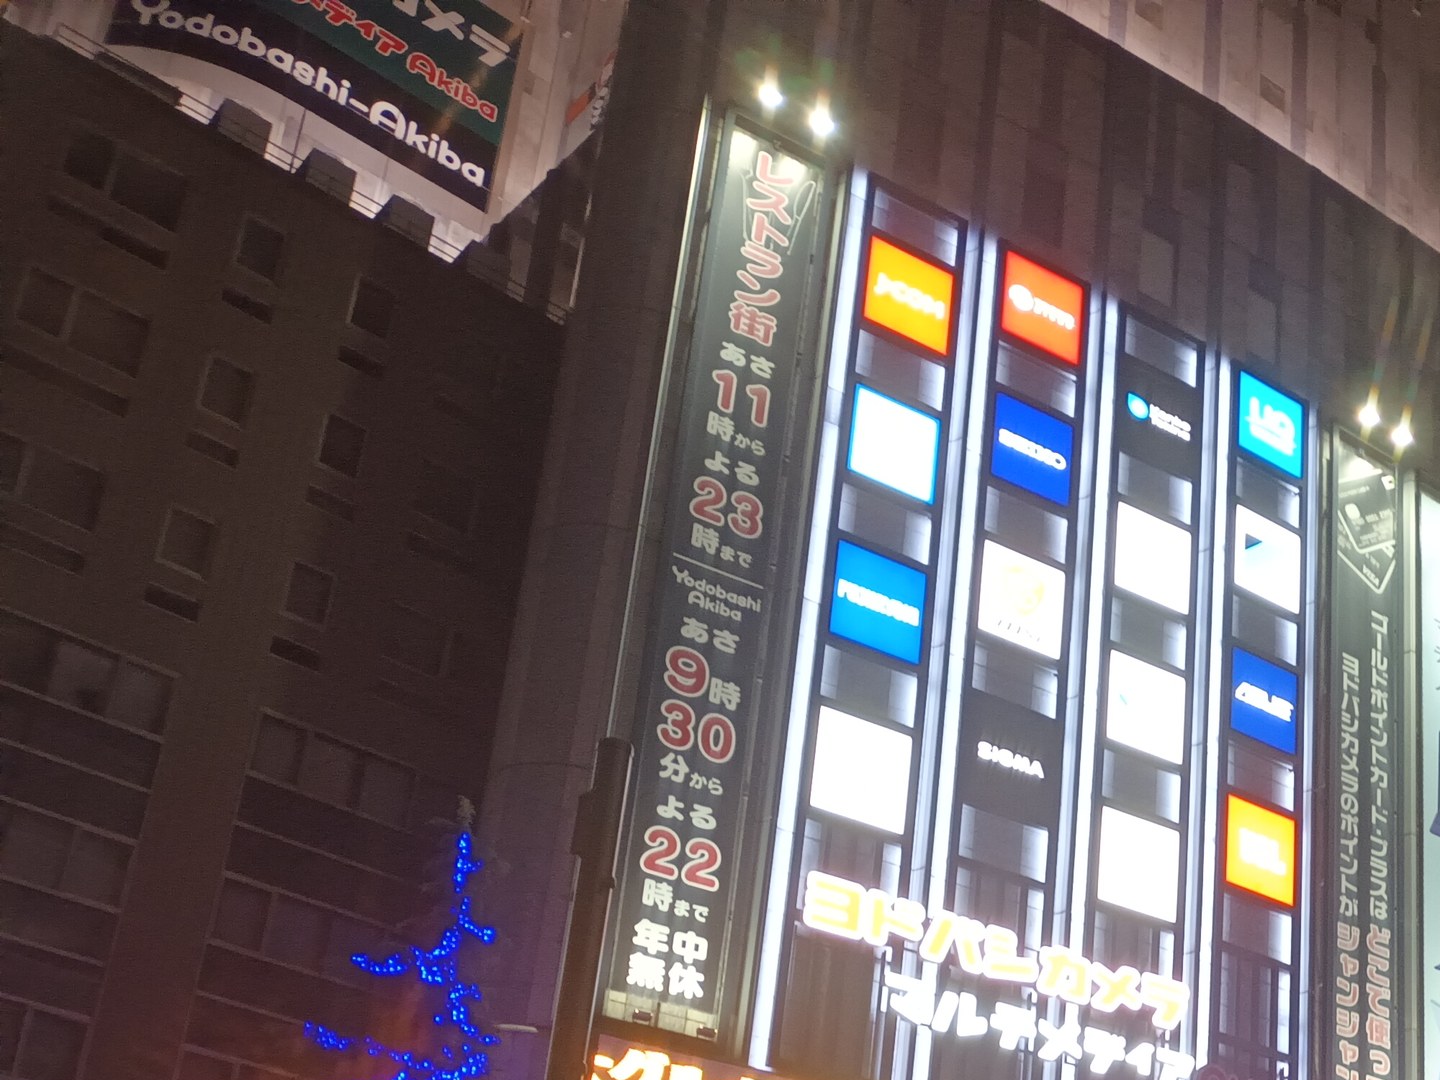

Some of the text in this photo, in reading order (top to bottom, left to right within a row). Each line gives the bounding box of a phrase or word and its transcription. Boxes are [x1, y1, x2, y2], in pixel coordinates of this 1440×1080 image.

[131, 0, 486, 188] Yodobashi-Akiba
[406, 52, 498, 122] Akiba
[729, 150, 795, 348] レストラン街
[719, 341, 776, 379] あさ
[711, 369, 771, 428] 11
[705, 410, 766, 458] 時から
[703, 450, 761, 487] よる
[689, 475, 764, 539] 23
[690, 521, 753, 570] 時まで
[671, 564, 762, 613] Yodobashi
[687, 590, 742, 622] Akiba
[679, 617, 741, 655] あさ
[663, 645, 742, 712] 9時
[655, 698, 737, 765] 30
[657, 752, 725, 797] 分から
[977, 740, 1046, 780] SIGMA
[1338, 651, 1361, 918] ヨドバシカメラのポイントが
[655, 795, 718, 831] よる
[638, 825, 723, 893] 22
[640, 878, 711, 923] 時まで
[631, 917, 710, 965] 年中
[802, 870, 1191, 1031] ヨドバシカメラ
[625, 953, 706, 1001] 無休
